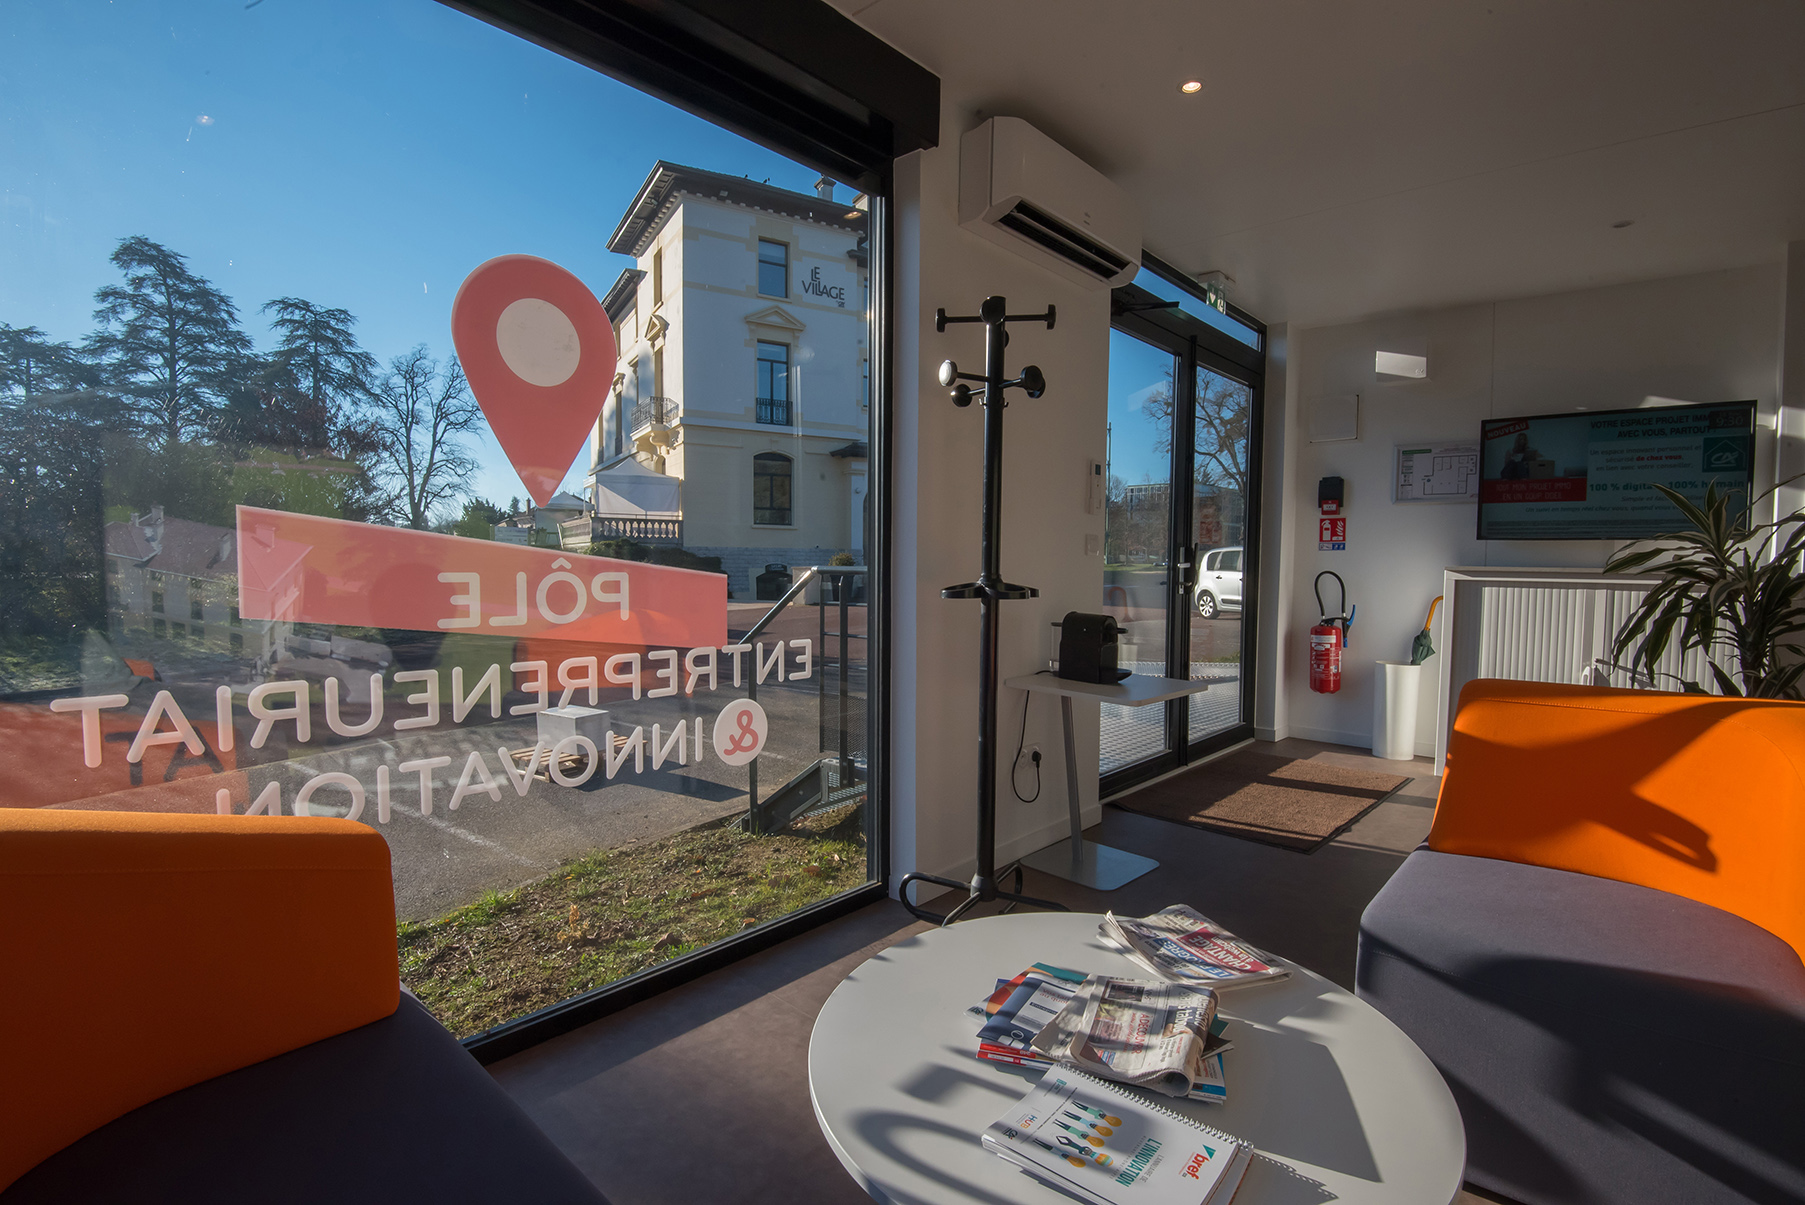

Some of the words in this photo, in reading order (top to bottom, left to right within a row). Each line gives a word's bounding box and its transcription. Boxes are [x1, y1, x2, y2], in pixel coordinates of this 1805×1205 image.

[802, 280, 845, 301] VILLAGE
[1487, 422, 1527, 439] NOUVEAU
[1591, 419, 1618, 429] VOTRE
[1620, 417, 1653, 427] ESPACE
[1655, 415, 1689, 425] PROJET
[1617, 429, 1640, 439] AVEC
[1589, 483, 1608, 491] 100
[1622, 481, 1655, 492] digita
[1701, 479, 1745, 490] hmain
[1189, 935, 1252, 970] CHANTAGE
[1115, 1138, 1163, 1188] L'INNOVATION
[1186, 1153, 1210, 1180] bref
